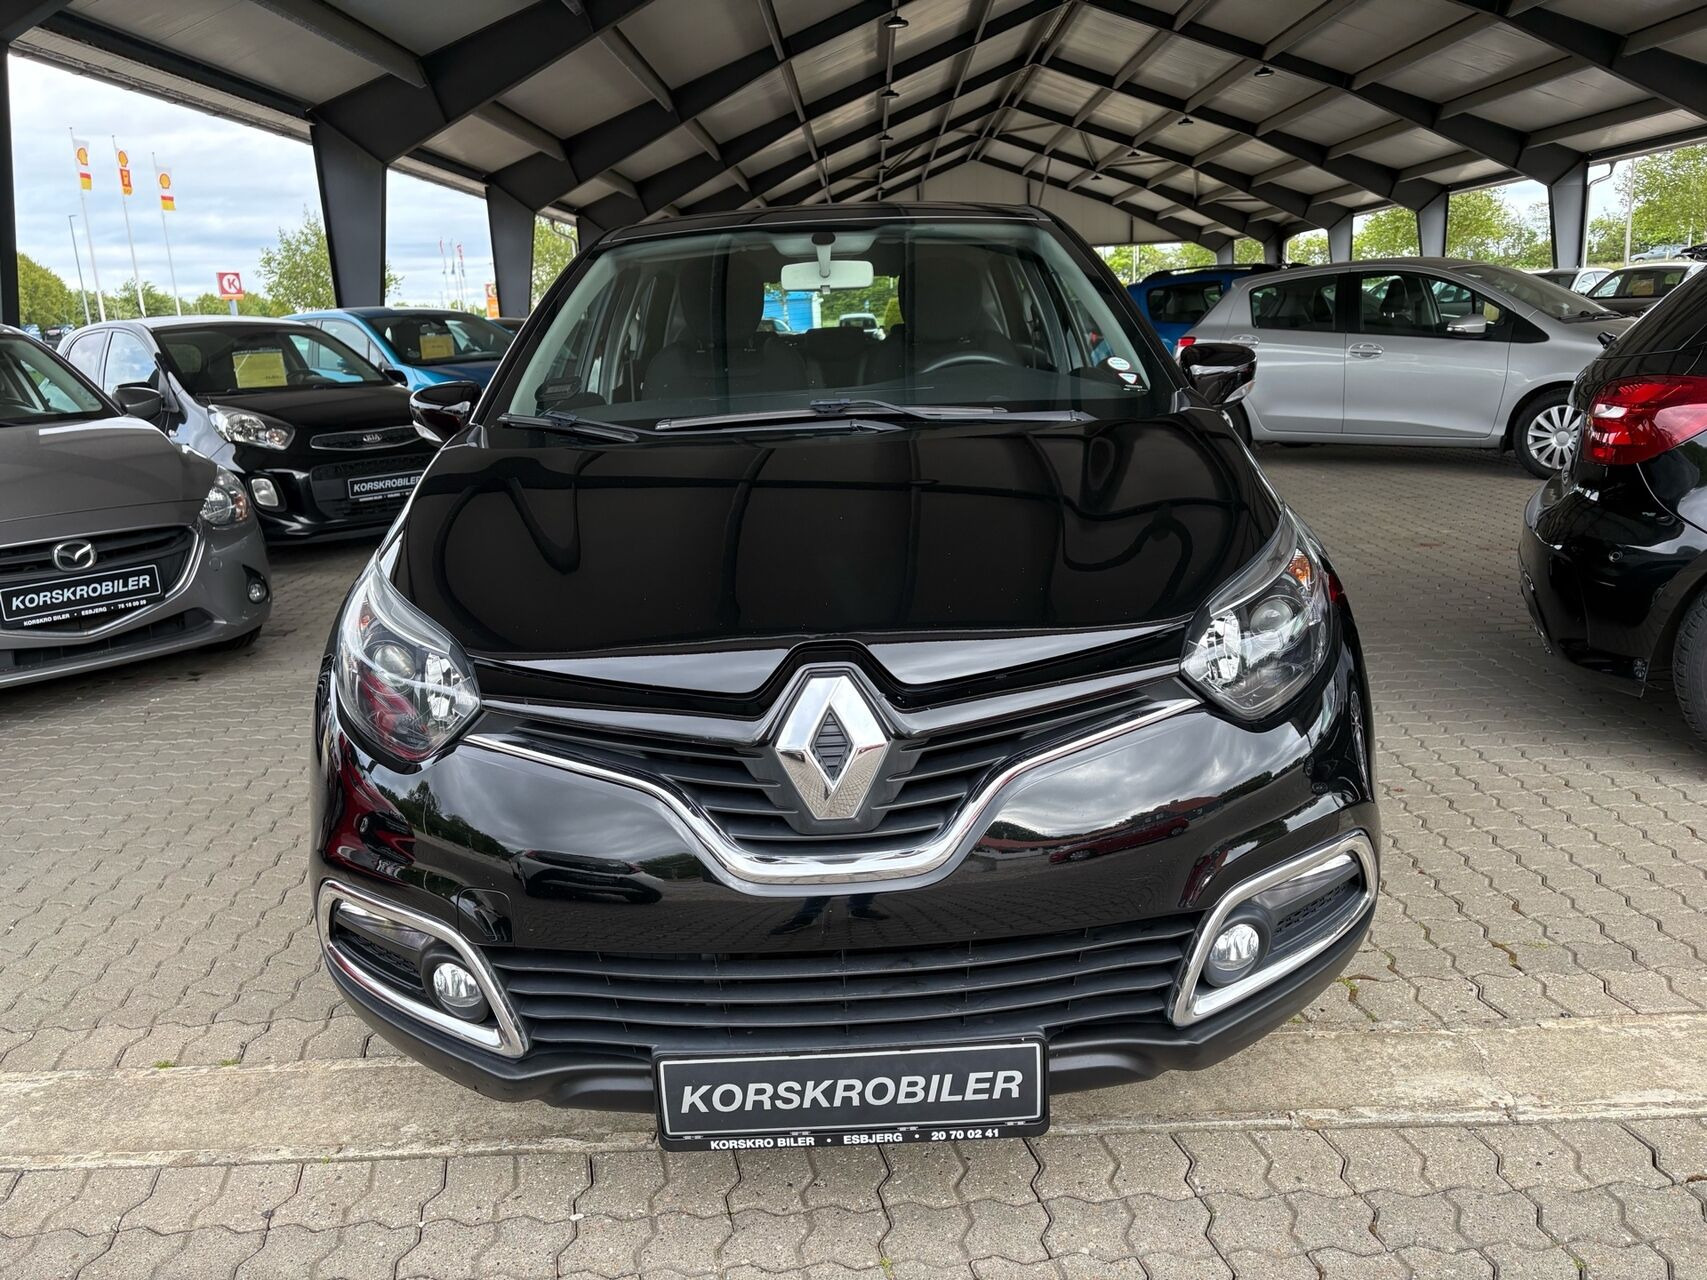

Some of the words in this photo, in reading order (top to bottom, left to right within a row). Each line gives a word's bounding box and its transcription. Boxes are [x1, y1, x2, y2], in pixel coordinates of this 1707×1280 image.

[11, 574, 151, 611] KORSKROBILER
[23, 615, 52, 626] KORSKRO
[53, 613, 70, 622] BILER
[81, 606, 107, 616] ESBJERG
[680, 1070, 1023, 1114] KORSKROBILER
[710, 1138, 774, 1150] KORSKRO
[777, 1136, 815, 1147] BILER
[843, 1133, 903, 1145] ESBJERG
[931, 1131, 946, 1140] 20
[949, 1130, 964, 1139] 70
[967, 1129, 982, 1139] 02
[985, 1128, 999, 1138] 41
